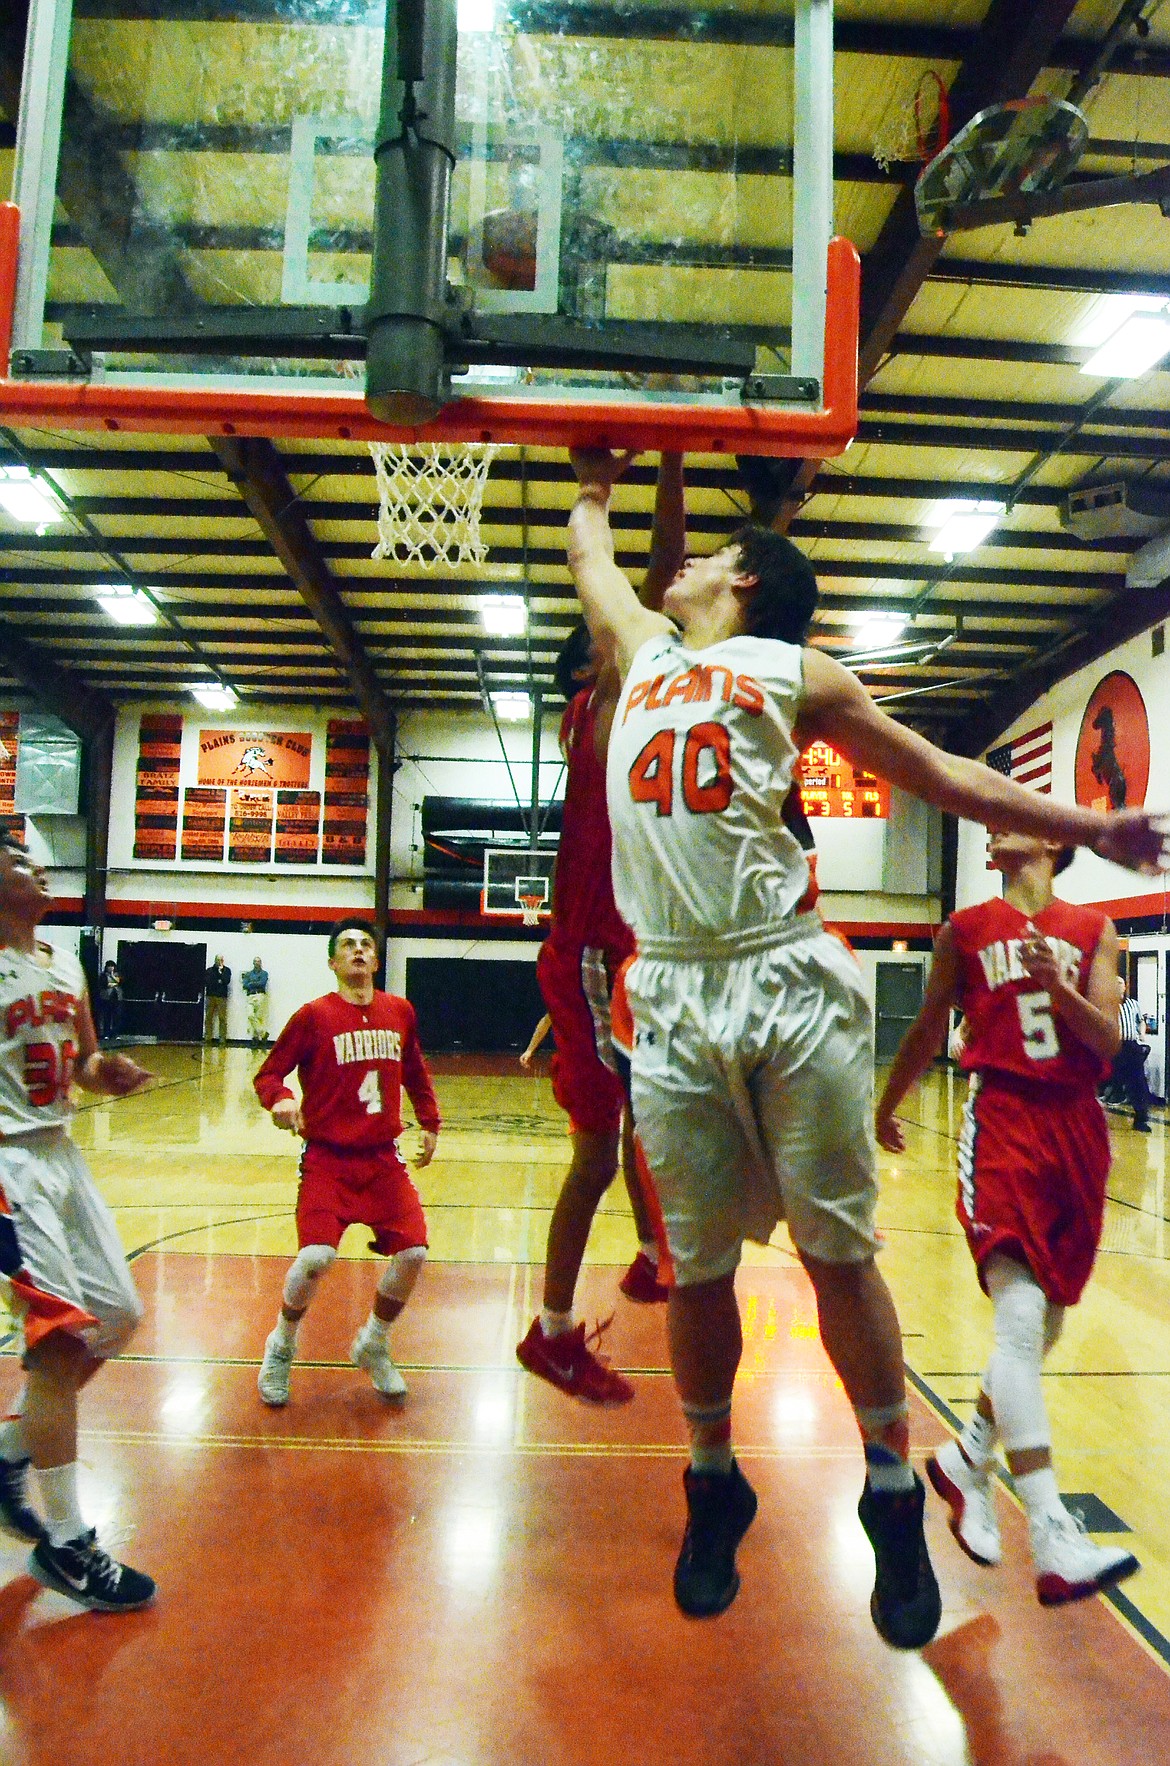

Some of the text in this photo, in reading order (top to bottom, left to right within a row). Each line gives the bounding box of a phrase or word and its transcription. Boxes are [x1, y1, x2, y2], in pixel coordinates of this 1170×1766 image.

[622, 664, 766, 727] PLAINS
[201, 734, 236, 753] PLAINS
[285, 739, 311, 757] CLUB
[140, 778, 176, 786] FAMILY
[198, 778, 216, 786] HOME
[217, 778, 225, 786] OF
[628, 721, 734, 817] 40
[1016, 990, 1061, 1060] 5
[332, 1029, 401, 1066] WARRIORS
[356, 1068, 383, 1115] 4
